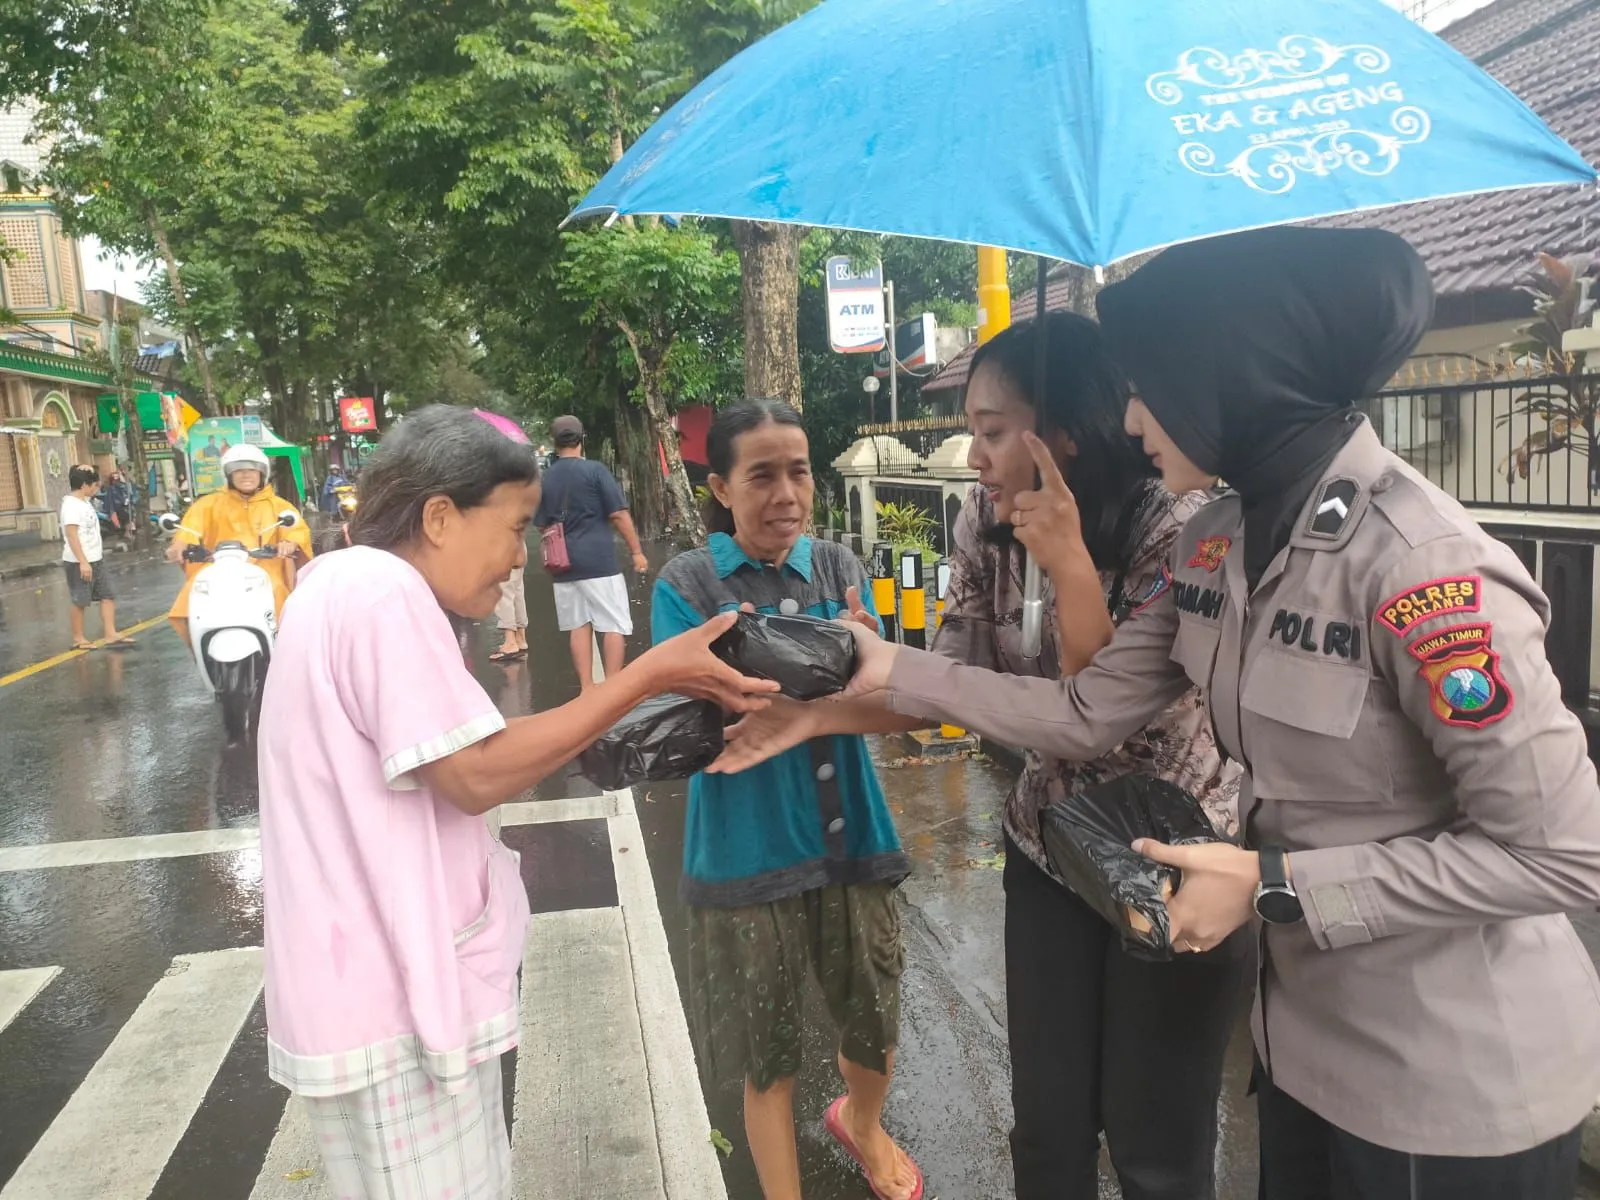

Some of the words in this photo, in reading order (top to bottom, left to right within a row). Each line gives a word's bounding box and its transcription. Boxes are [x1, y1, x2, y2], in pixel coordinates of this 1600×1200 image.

[1170, 110, 1242, 136] EKA
[1251, 104, 1279, 126] &
[1288, 81, 1404, 120] AGENG
[840, 303, 875, 316] ATM
[1384, 581, 1474, 624] POLRES
[1268, 608, 1361, 661] POLRI
[1447, 628, 1483, 642] TIMUR
